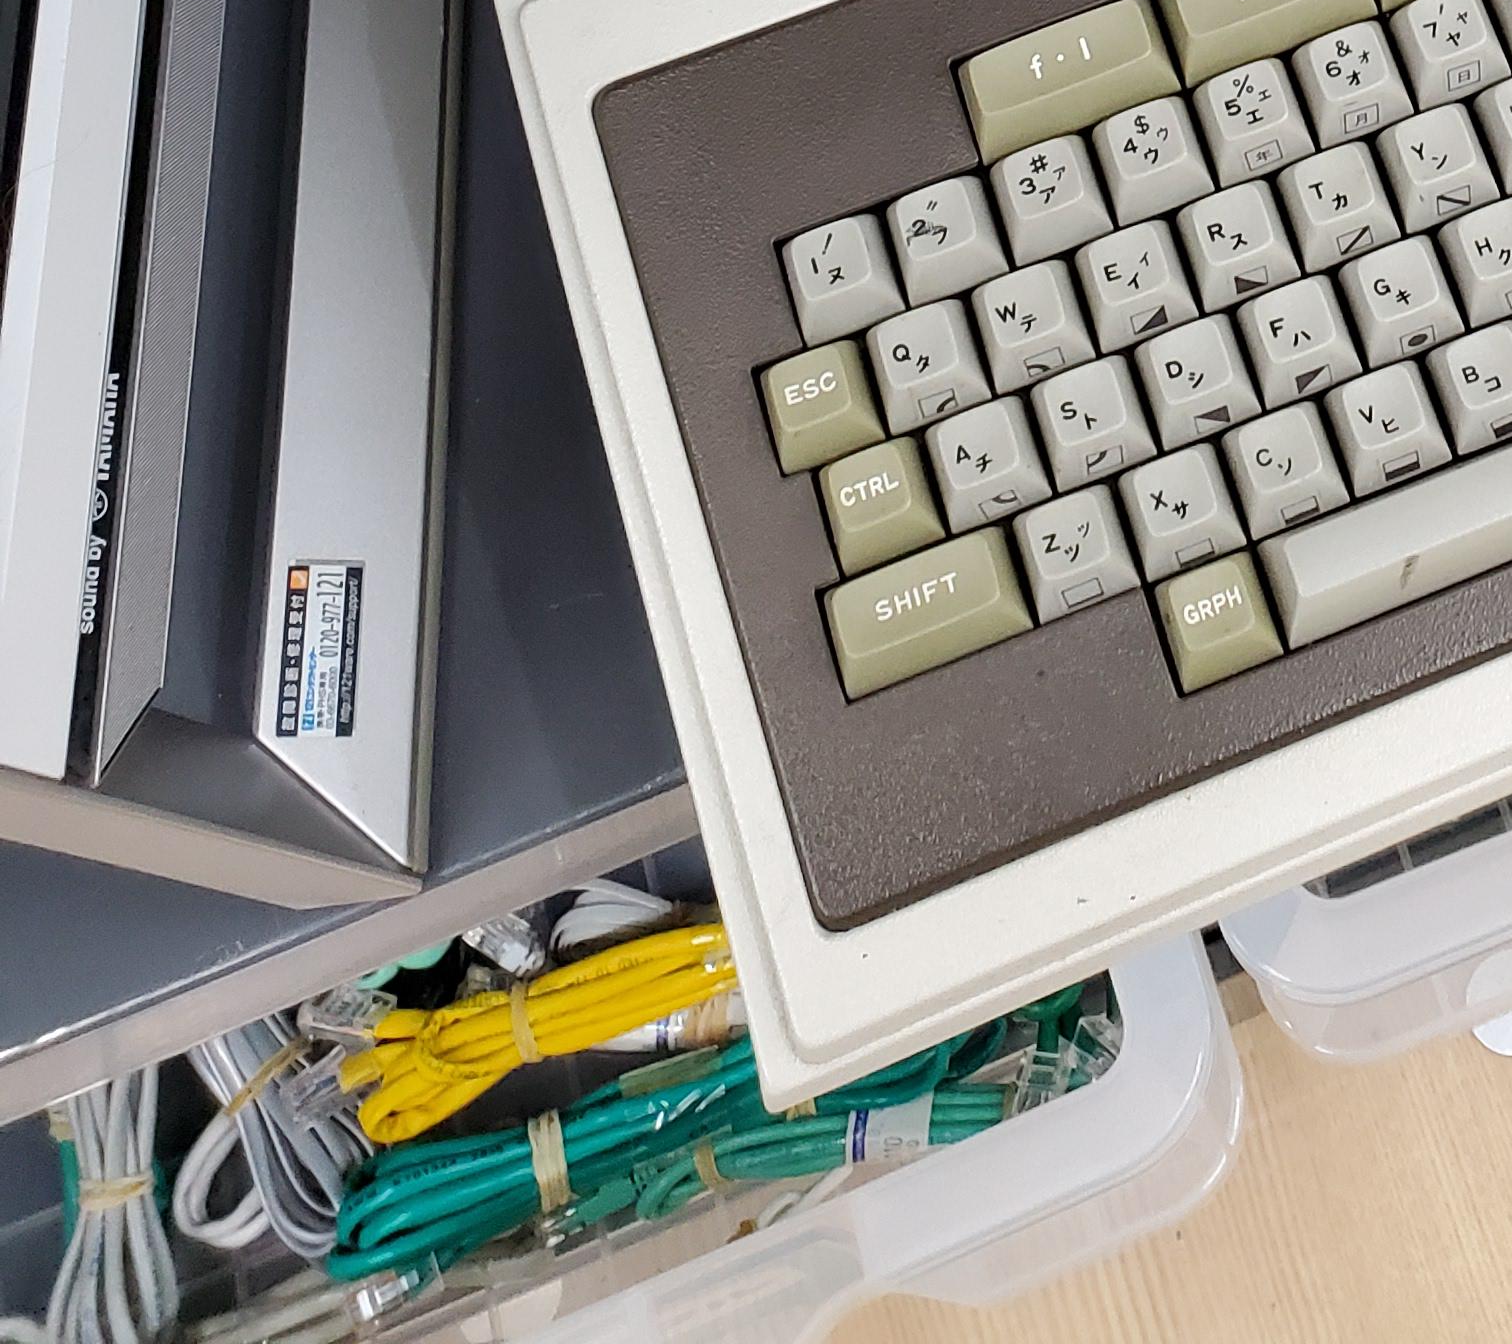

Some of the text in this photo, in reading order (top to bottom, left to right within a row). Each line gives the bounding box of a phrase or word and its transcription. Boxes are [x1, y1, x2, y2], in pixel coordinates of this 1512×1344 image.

[1423, 20, 1438, 39] 7
[1325, 60, 1342, 78] 6
[1225, 98, 1242, 116] 5
[1123, 137, 1138, 155] 4
[1410, 143, 1425, 162] Y
[1018, 177, 1037, 195] 3
[1308, 182, 1324, 200] T
[1207, 223, 1225, 242] R
[1474, 237, 1493, 256] H
[1104, 263, 1121, 282] E
[1374, 279, 1391, 296] G
[995, 302, 1017, 323] W
[1269, 317, 1285, 338] F
[892, 344, 911, 363] Q
[1165, 360, 1183, 378] D
[1462, 365, 1480, 384] B
[783, 371, 838, 407] ESC
[1060, 401, 1078, 420] S
[1358, 405, 1373, 424] V
[955, 444, 971, 465] A
[1256, 448, 1272, 467] C
[839, 472, 899, 508] CTRL
[1149, 490, 1168, 510] X
[1042, 533, 1060, 553] Z
[875, 571, 958, 622] SHIFT
[1183, 585, 1243, 626] GRPH
[316, 572, 344, 658] 0120-977-121
